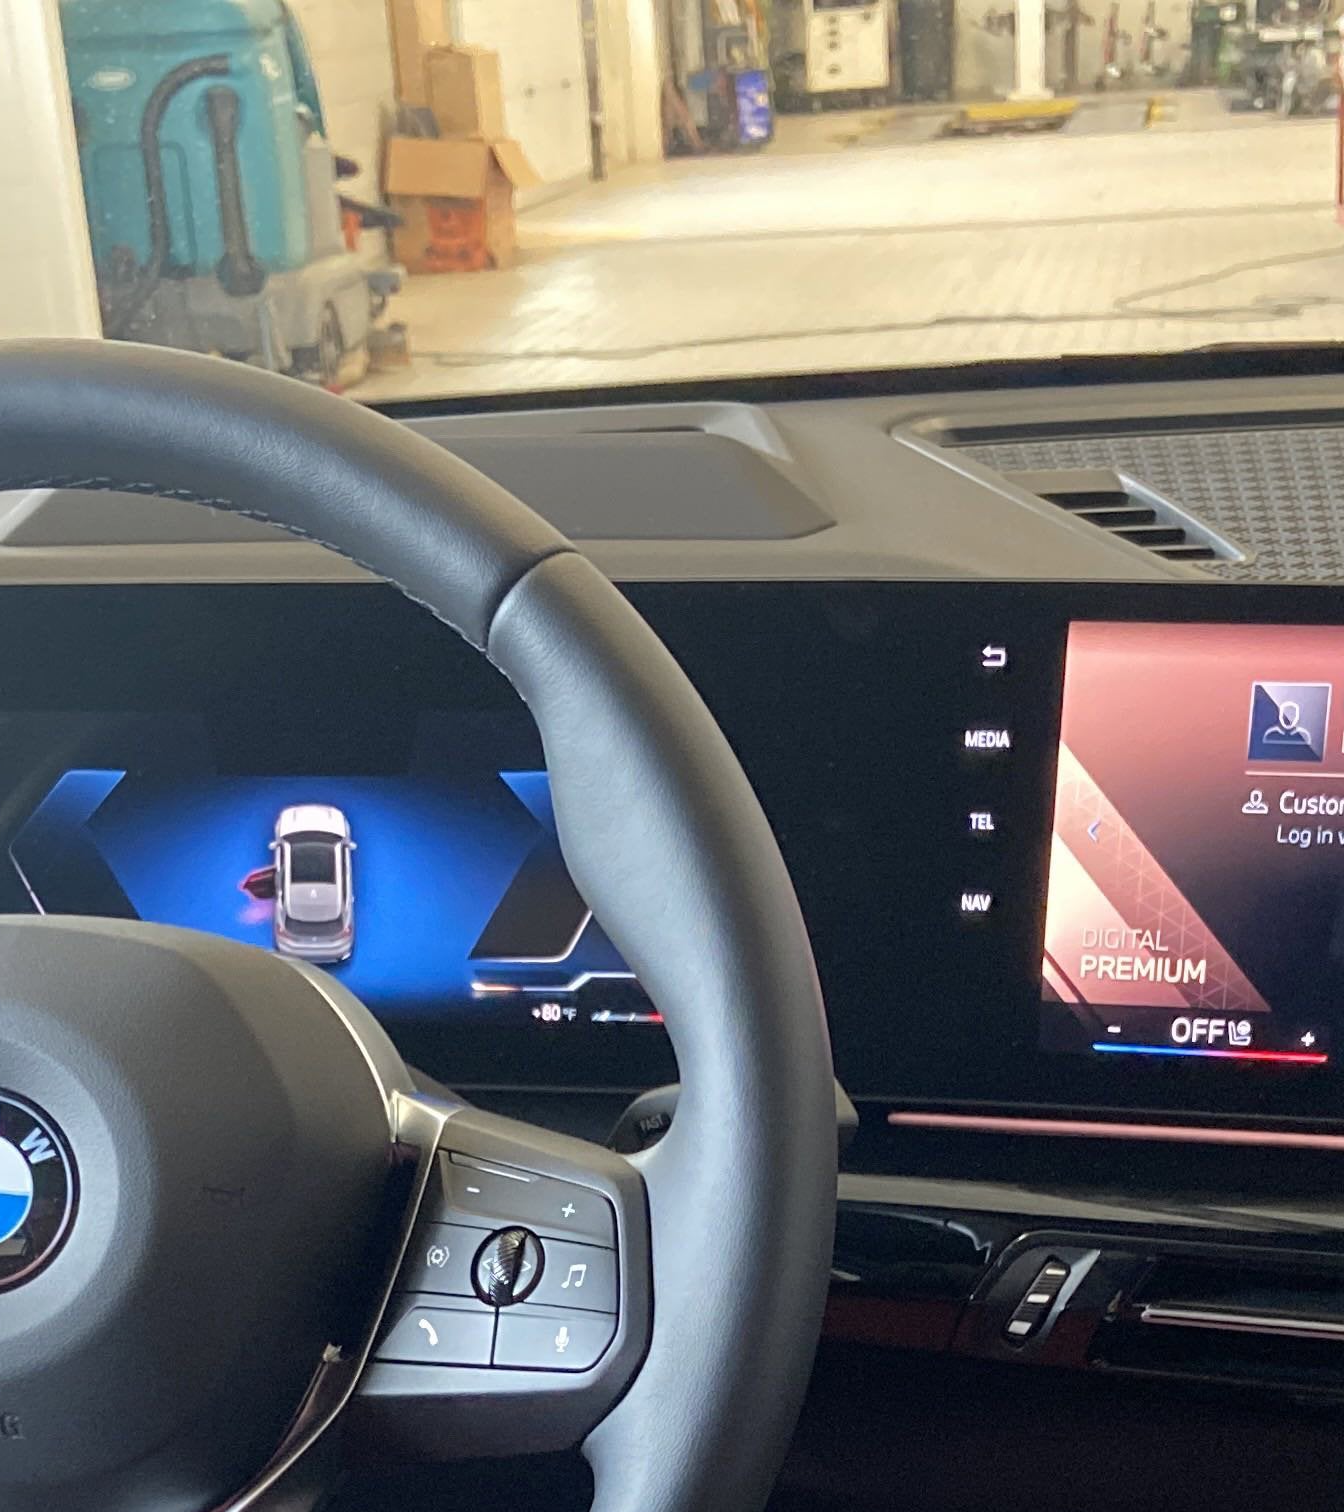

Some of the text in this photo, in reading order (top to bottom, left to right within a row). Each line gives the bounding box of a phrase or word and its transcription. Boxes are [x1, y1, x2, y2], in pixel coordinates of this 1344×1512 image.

[964, 730, 1010, 749] MEDIA
[969, 812, 994, 831] TEL
[1277, 825, 1311, 848] Log
[1317, 827, 1332, 844] in
[961, 893, 991, 911] NAV
[1081, 928, 1170, 952] DIGITAL
[1080, 955, 1206, 984] PREMIUM
[1171, 1017, 1226, 1045] OFF
